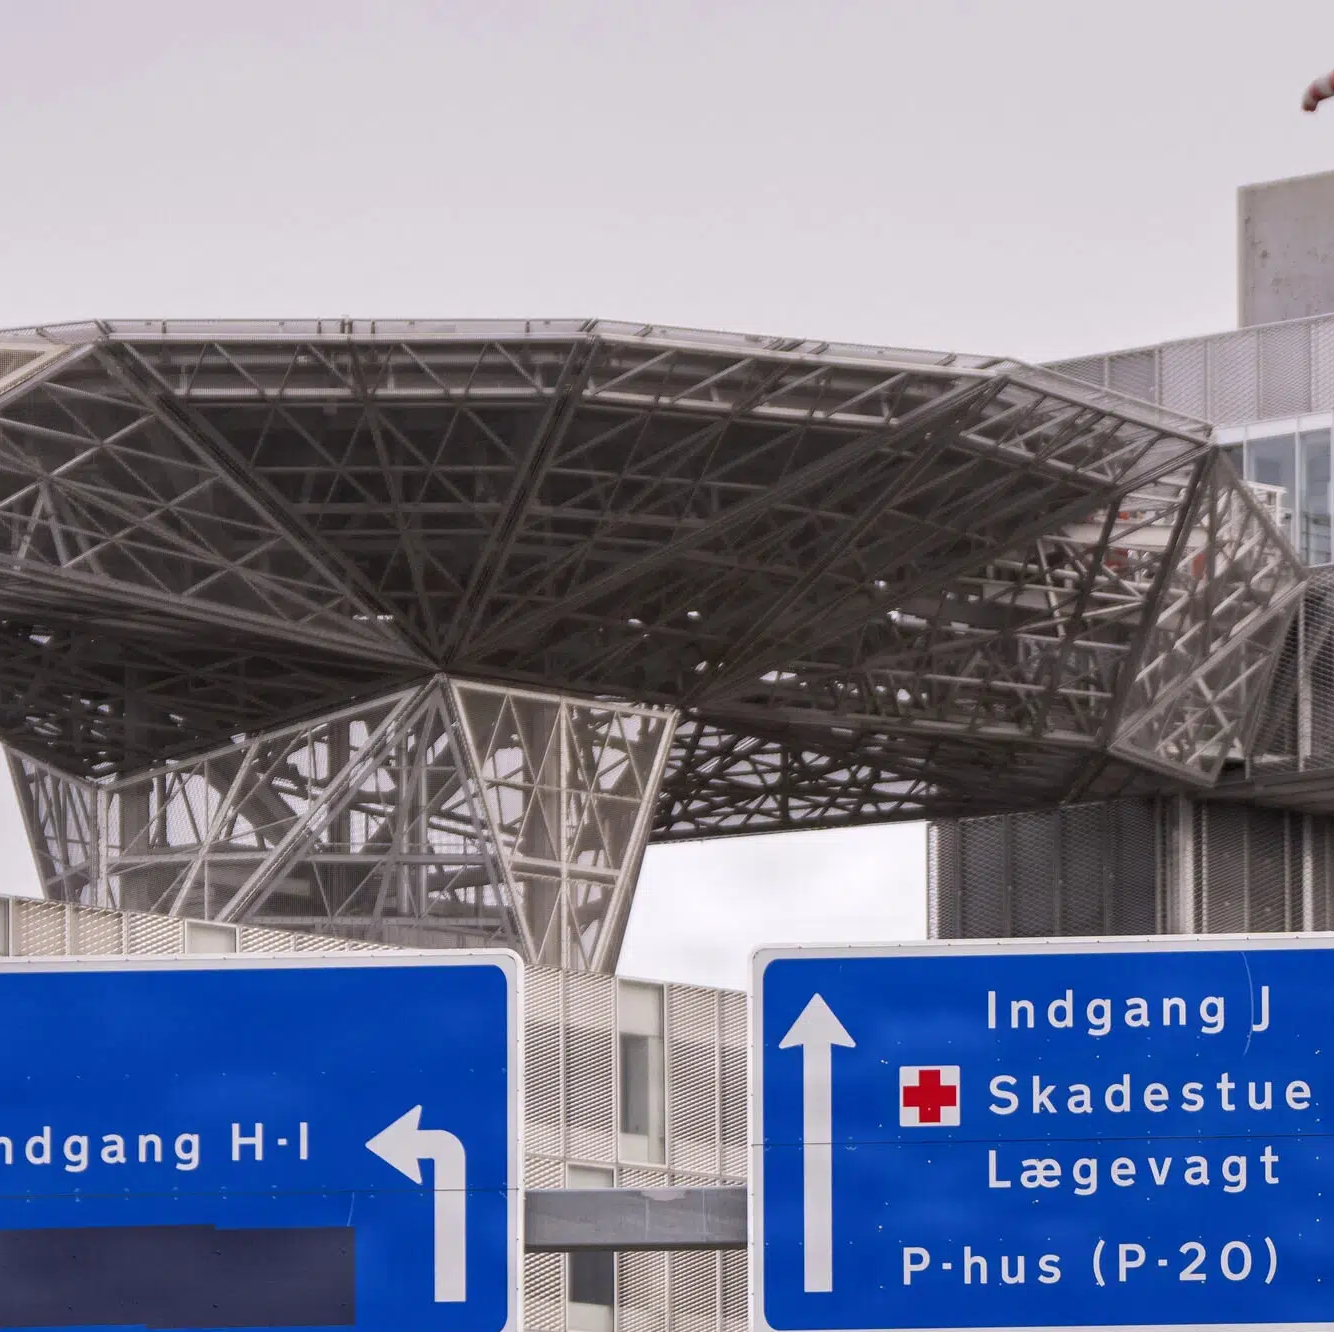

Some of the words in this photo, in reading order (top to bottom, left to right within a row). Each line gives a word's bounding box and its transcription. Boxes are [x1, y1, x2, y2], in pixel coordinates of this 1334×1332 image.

[987, 988, 1225, 1036] Indgang
[1251, 985, 1271, 1033] J
[988, 1072, 1312, 1116] Skadestue
[231, 1121, 309, 1162] H-I
[988, 1145, 1280, 1196] Lægevagt
[902, 1246, 1062, 1287] P-hus
[1092, 1236, 1278, 1288] (P-20)
